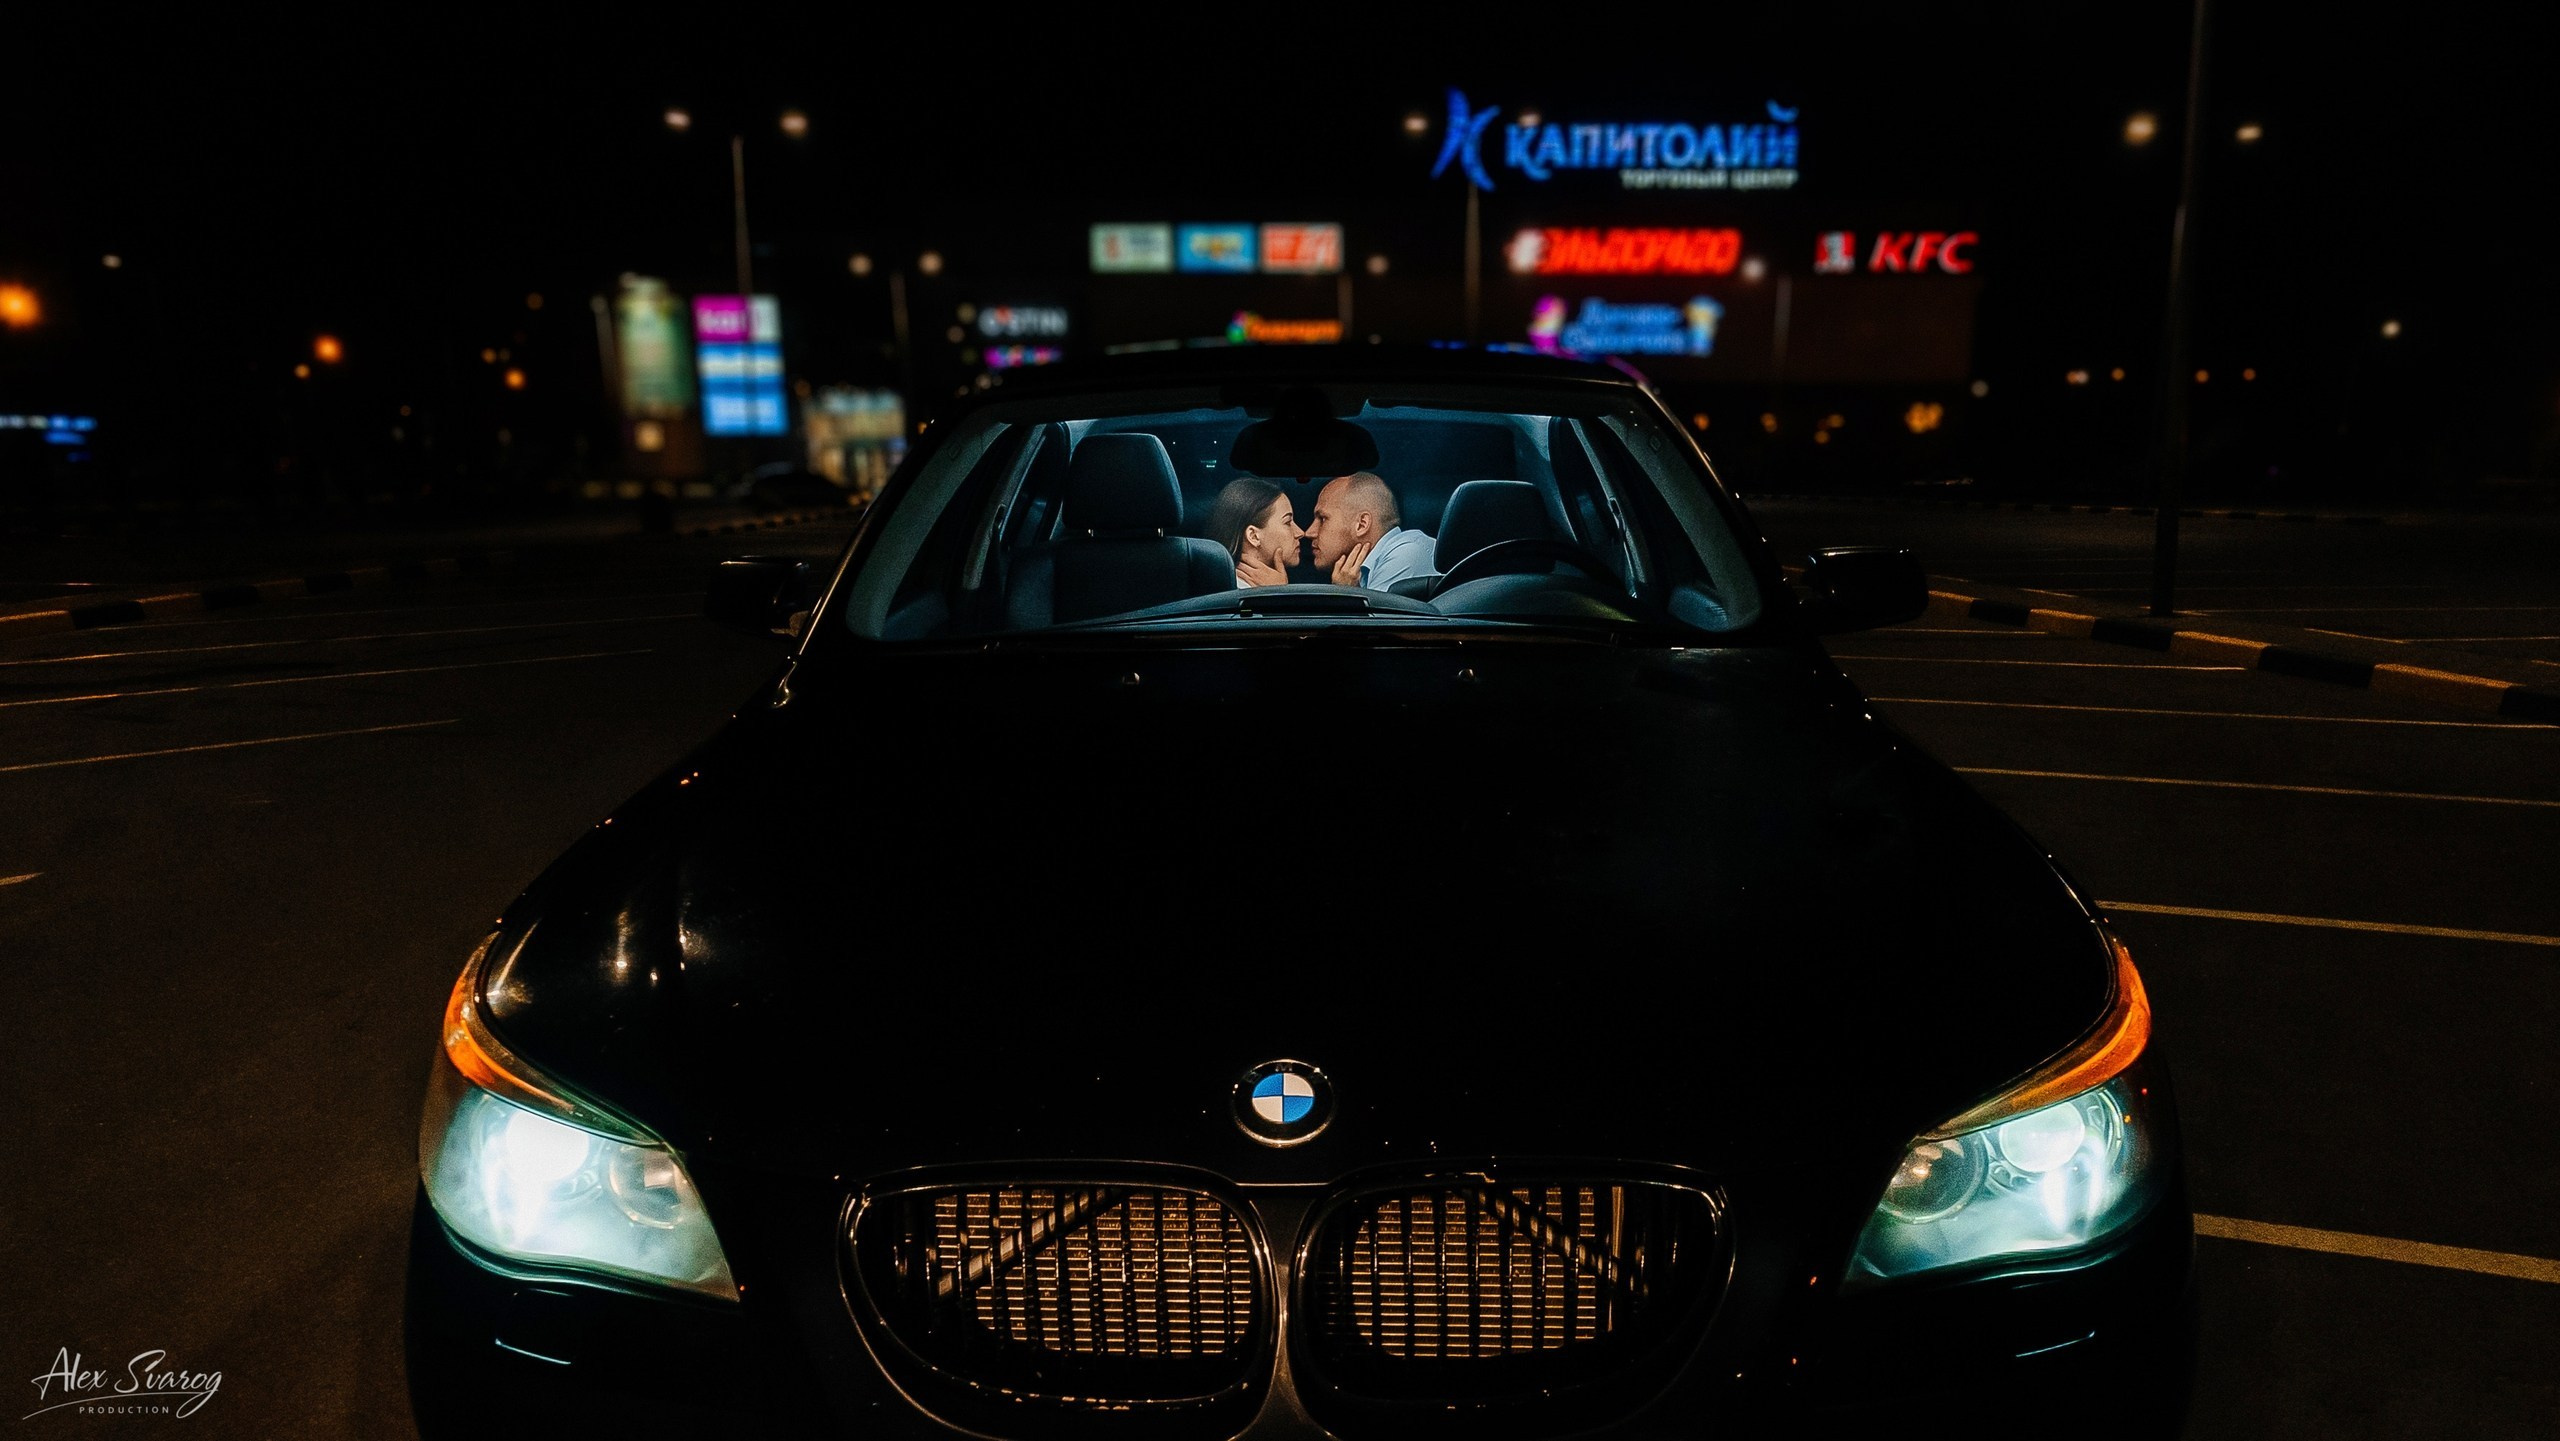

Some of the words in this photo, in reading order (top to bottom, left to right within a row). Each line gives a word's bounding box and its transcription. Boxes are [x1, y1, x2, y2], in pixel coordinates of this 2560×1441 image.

[1504, 100, 1800, 181] КАПИТОЛИЙ
[1731, 169, 1799, 190] ЦЕНТР
[1868, 231, 1980, 274] KFC
